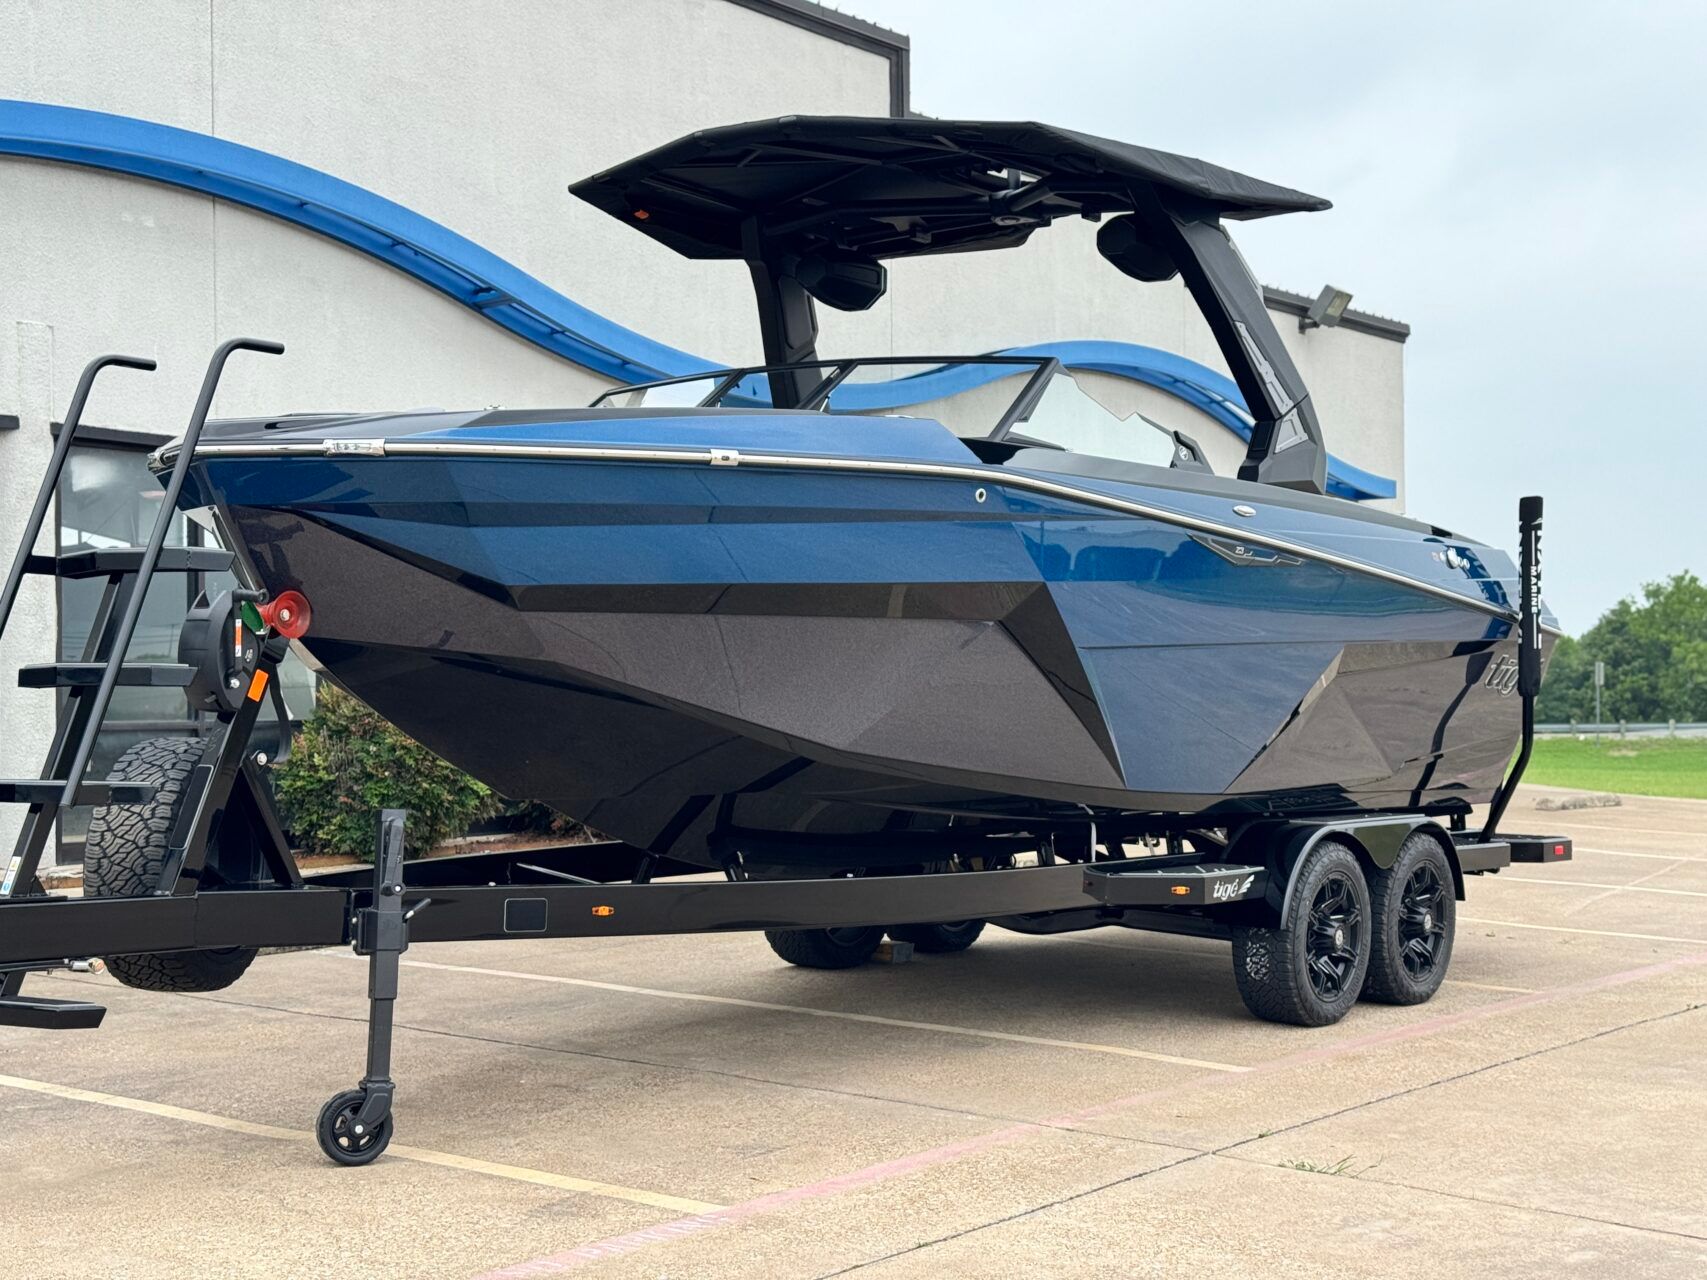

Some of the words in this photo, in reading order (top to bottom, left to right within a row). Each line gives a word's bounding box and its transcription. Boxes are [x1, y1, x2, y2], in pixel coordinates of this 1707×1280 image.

[1530, 566, 1539, 614] MARINE
[1484, 654, 1523, 698] tig
[1213, 879, 1240, 901] tigé
